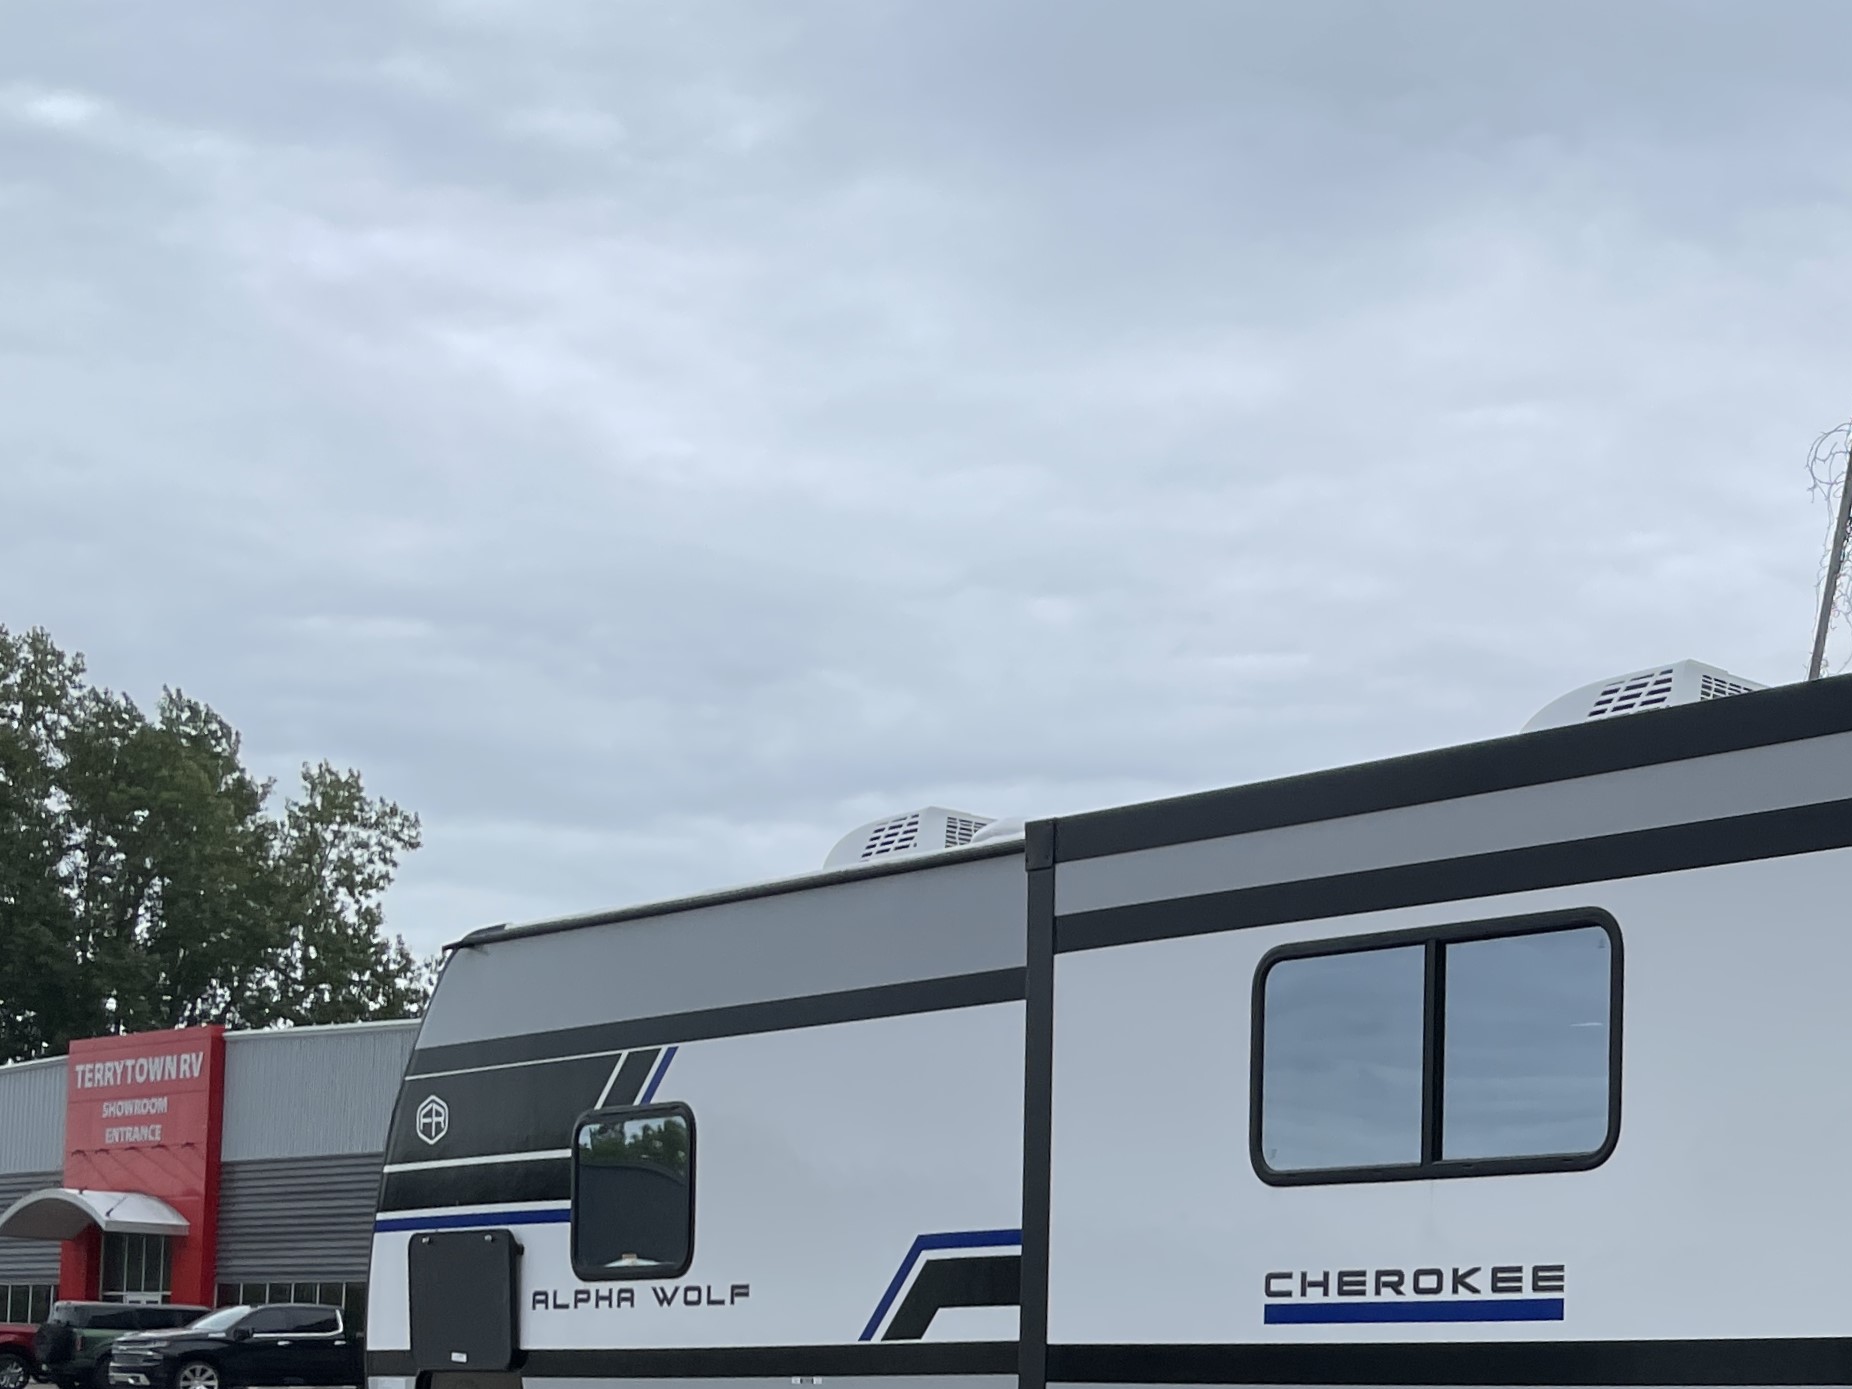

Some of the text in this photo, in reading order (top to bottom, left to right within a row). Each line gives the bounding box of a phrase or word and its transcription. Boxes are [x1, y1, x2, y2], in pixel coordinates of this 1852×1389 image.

[75, 1051, 204, 1089] TERRYTOWN RV
[102, 1097, 168, 1119] SHOWROOM
[105, 1124, 163, 1144] ENTRANCE
[1264, 1264, 1565, 1298] CHEROKEE
[531, 1283, 750, 1311] ALPHA WOLF
